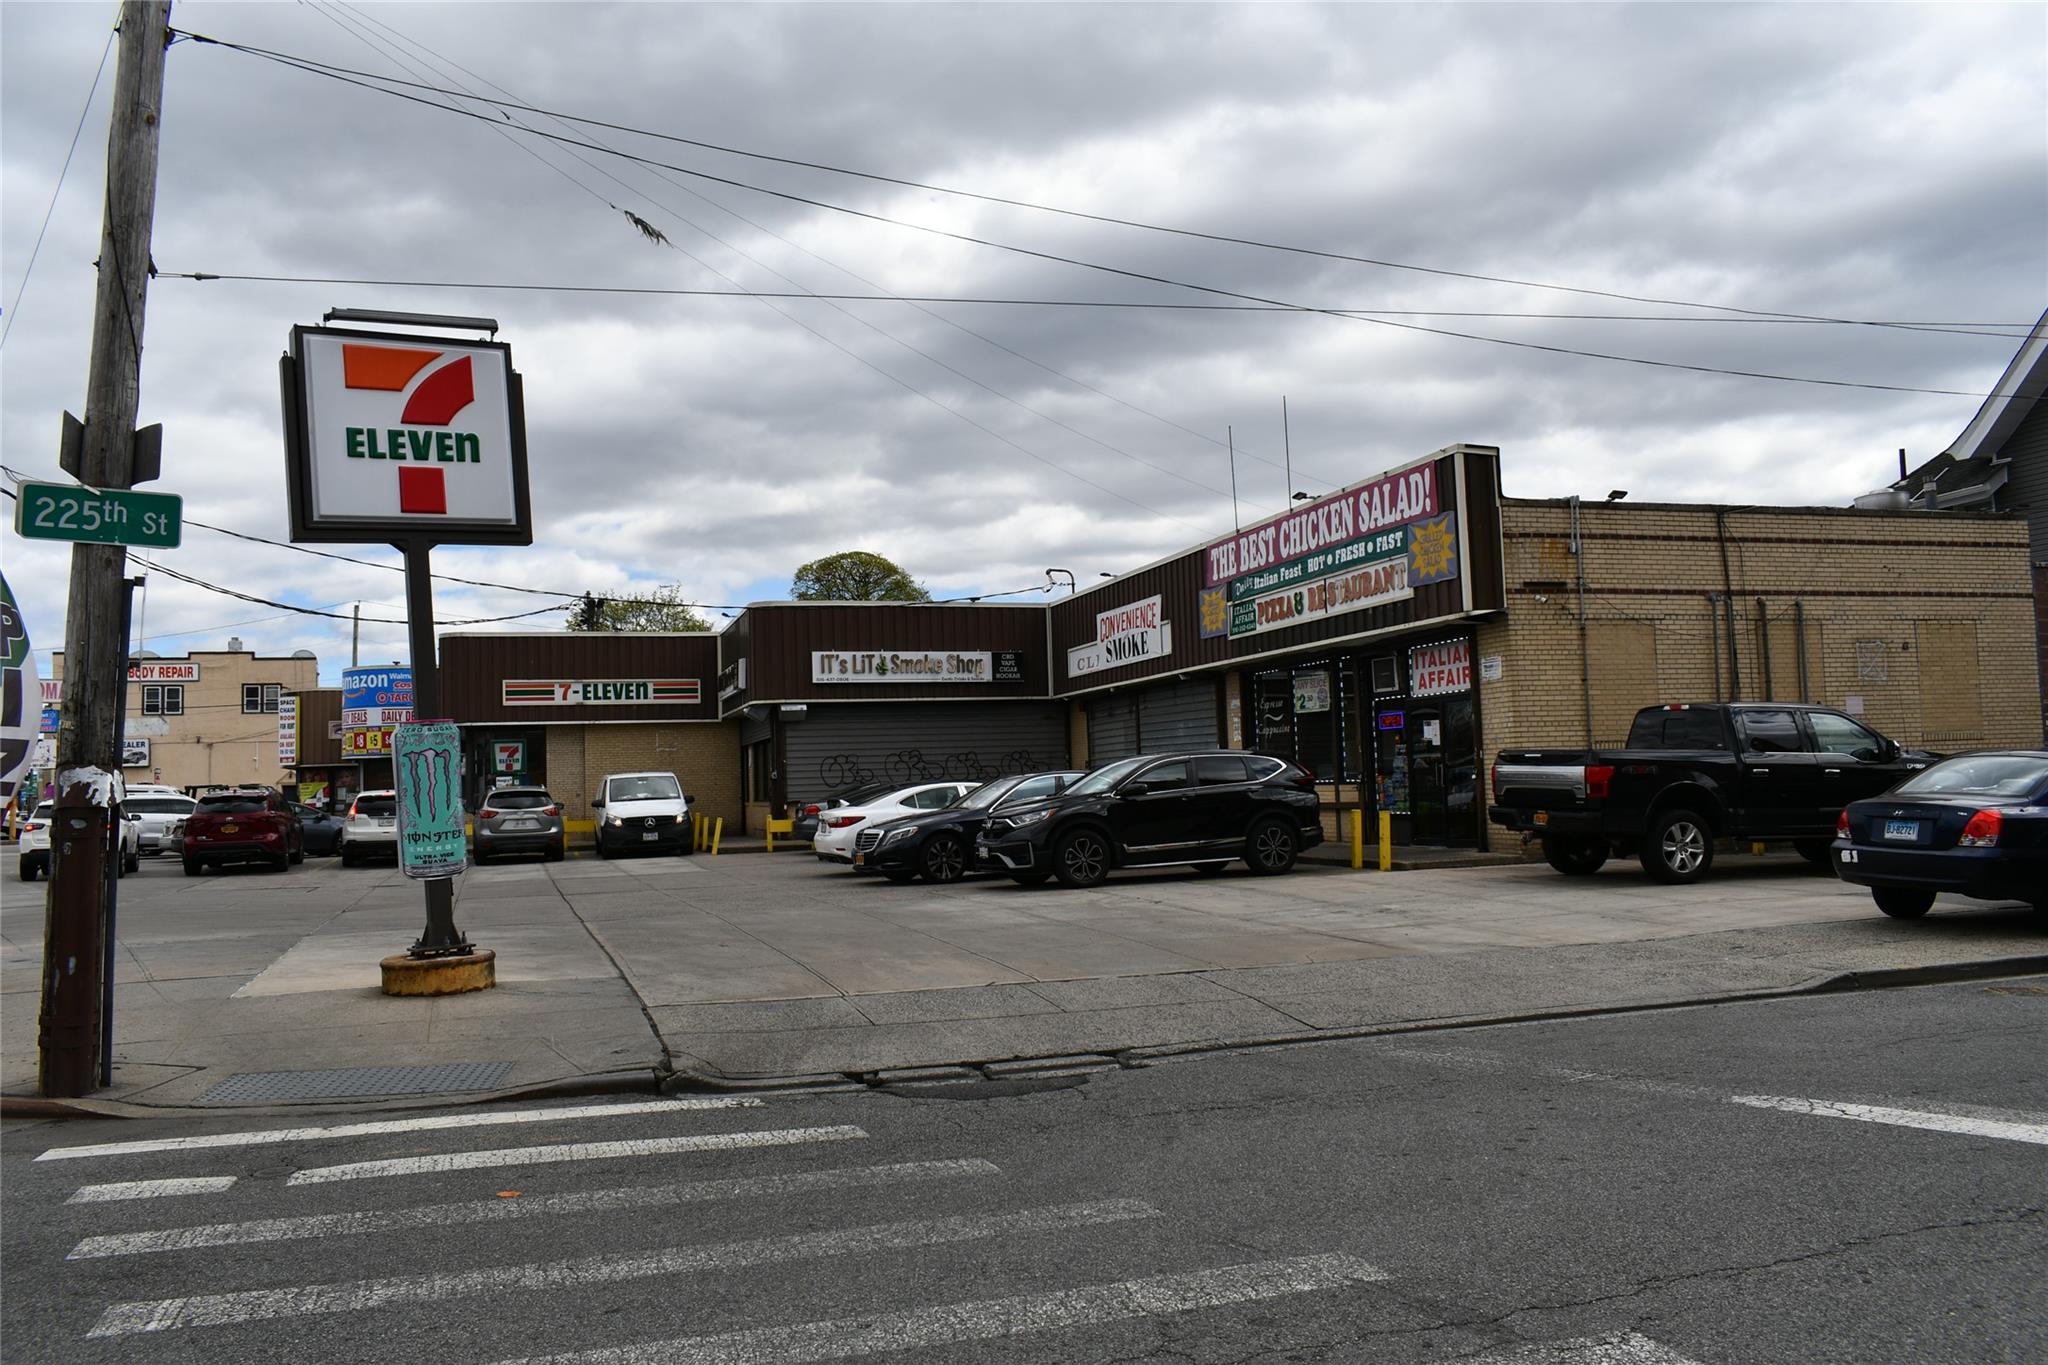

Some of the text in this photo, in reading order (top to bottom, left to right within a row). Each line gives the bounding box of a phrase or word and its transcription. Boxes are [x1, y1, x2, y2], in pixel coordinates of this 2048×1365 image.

[342, 343, 475, 515] 7
[34, 496, 168, 536] 225th St
[1210, 467, 1431, 581] THE BEST CHICKEN SALAD!
[1254, 570, 1279, 589] Italian
[1280, 563, 1302, 583] Feast
[1307, 554, 1326, 573] HOT
[1335, 541, 1365, 565] FRESH
[1376, 531, 1403, 553] FAST
[1256, 595, 1295, 626] PIZZA
[1308, 561, 1406, 613] RESTAURANT
[1100, 602, 1157, 643] CONVENIENCE
[1105, 631, 1149, 663] SMOKE
[1414, 645, 1471, 670] ITALIAN
[128, 667, 194, 679] BODY REPAIR
[890, 653, 944, 675] Smoke
[947, 653, 983, 677] Shop
[344, 673, 388, 690] mazon
[1418, 666, 1472, 690] AFFAIR
[351, 711, 368, 723] DEALS
[381, 710, 414, 722] DAILY DE
[122, 741, 146, 749] EALER
